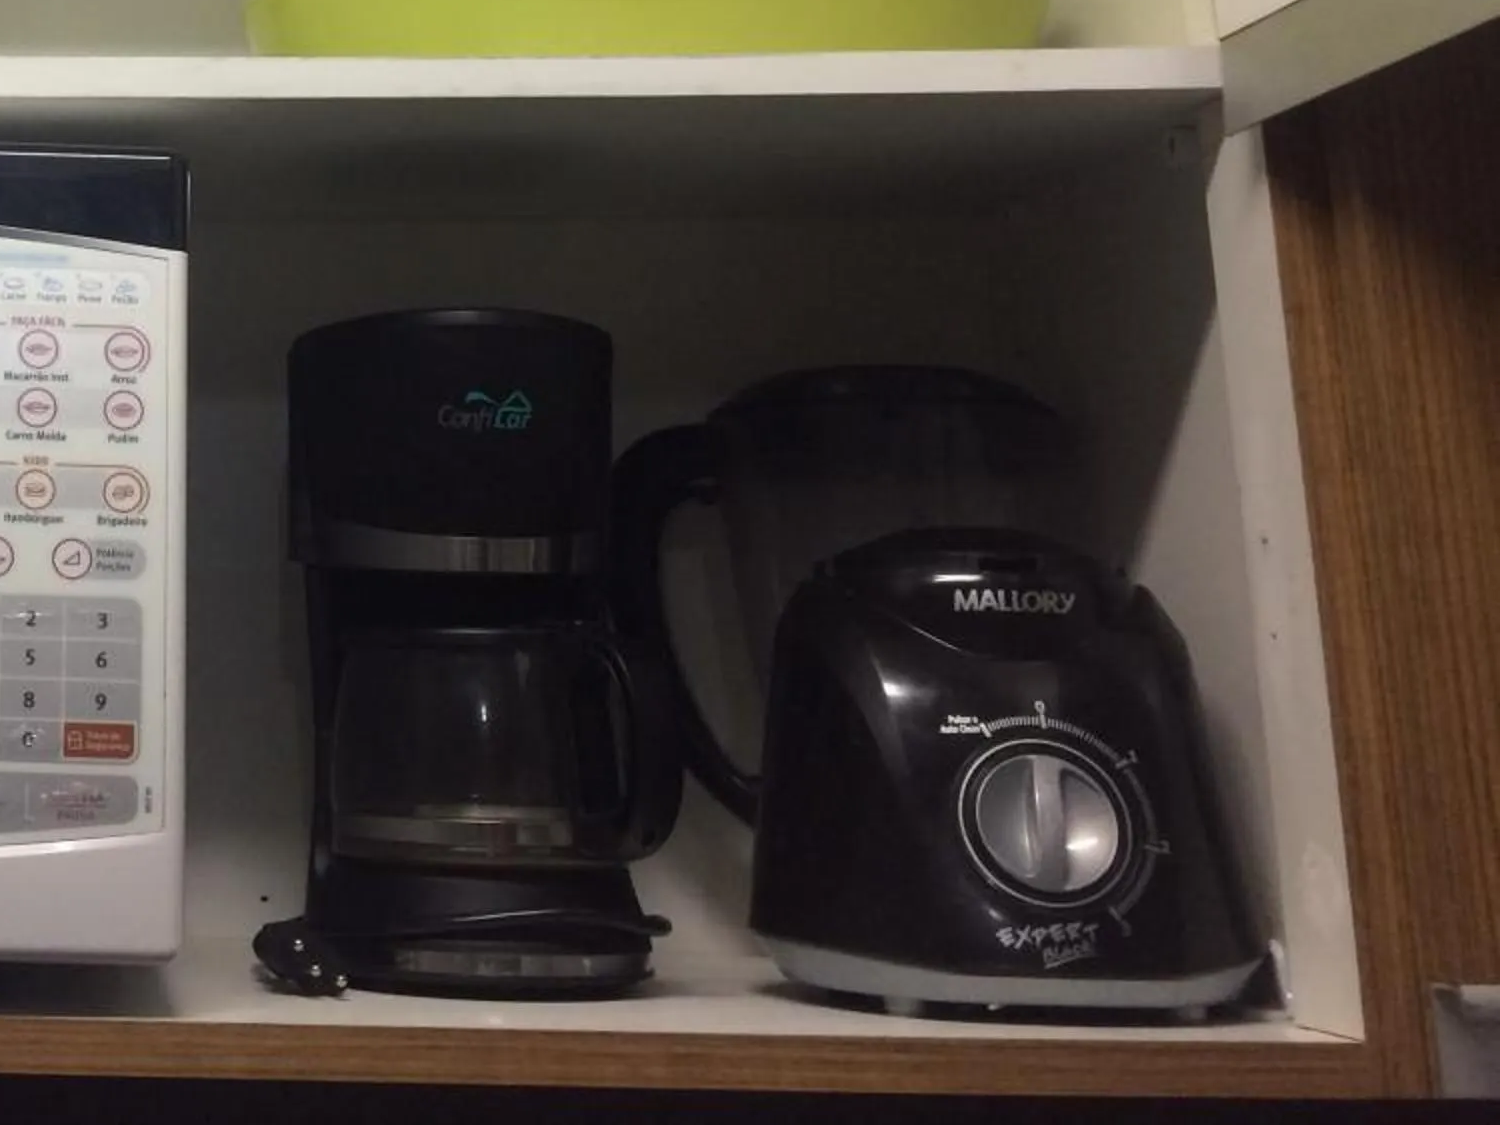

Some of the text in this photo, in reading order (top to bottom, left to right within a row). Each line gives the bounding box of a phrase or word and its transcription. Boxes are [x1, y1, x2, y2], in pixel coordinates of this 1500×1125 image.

[953, 588, 1076, 614] MALLORY
[25, 610, 37, 626] 2
[97, 612, 108, 629] 3
[25, 649, 36, 665] 5
[95, 651, 107, 668] 6
[23, 692, 35, 709] 8
[95, 693, 107, 710] 9
[996, 922, 1099, 950] EXPERT
